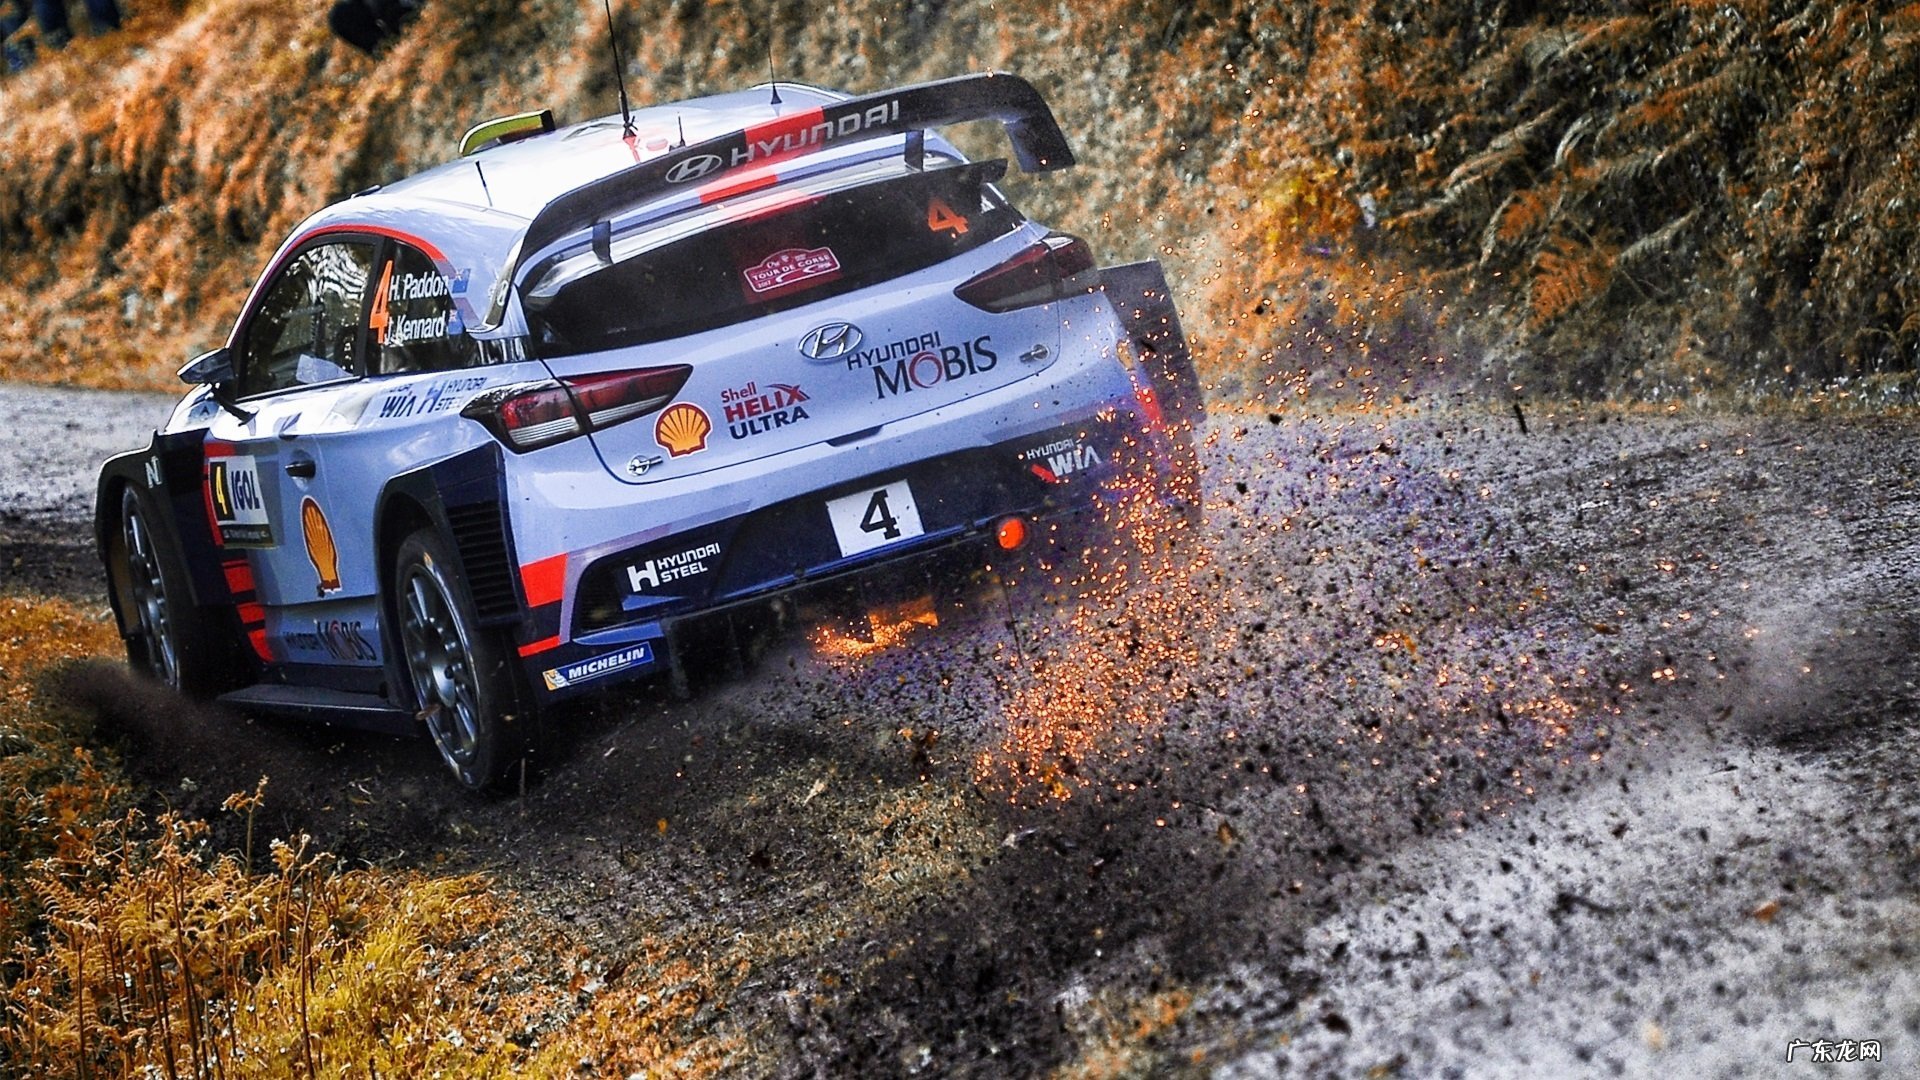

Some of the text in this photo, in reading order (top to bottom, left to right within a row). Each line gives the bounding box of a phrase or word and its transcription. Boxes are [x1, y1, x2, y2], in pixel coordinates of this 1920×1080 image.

[731, 100, 899, 167] HYUNDAI
[928, 197, 968, 233] 4
[752, 268, 781, 281] TOUR
[781, 264, 796, 273] DE
[797, 254, 830, 268] CORSE
[369, 260, 393, 344] 4
[388, 271, 449, 301] H. Paddon
[396, 310, 446, 342] Kennard
[846, 331, 941, 371] HYUNDAI
[872, 335, 998, 400] MOBIS
[721, 381, 757, 403] Shell
[723, 384, 811, 423] HELIX
[729, 405, 810, 440] ULTRA
[1026, 438, 1075, 460] HYUNDAI
[1048, 443, 1102, 477] WIA
[216, 466, 228, 515] 4
[231, 470, 261, 511] IGOL
[860, 488, 901, 540] 4
[657, 542, 720, 570] HYUNDAI
[660, 561, 708, 583] STEEL
[317, 619, 377, 661] MOBIS
[568, 647, 645, 679] MICHELIN
